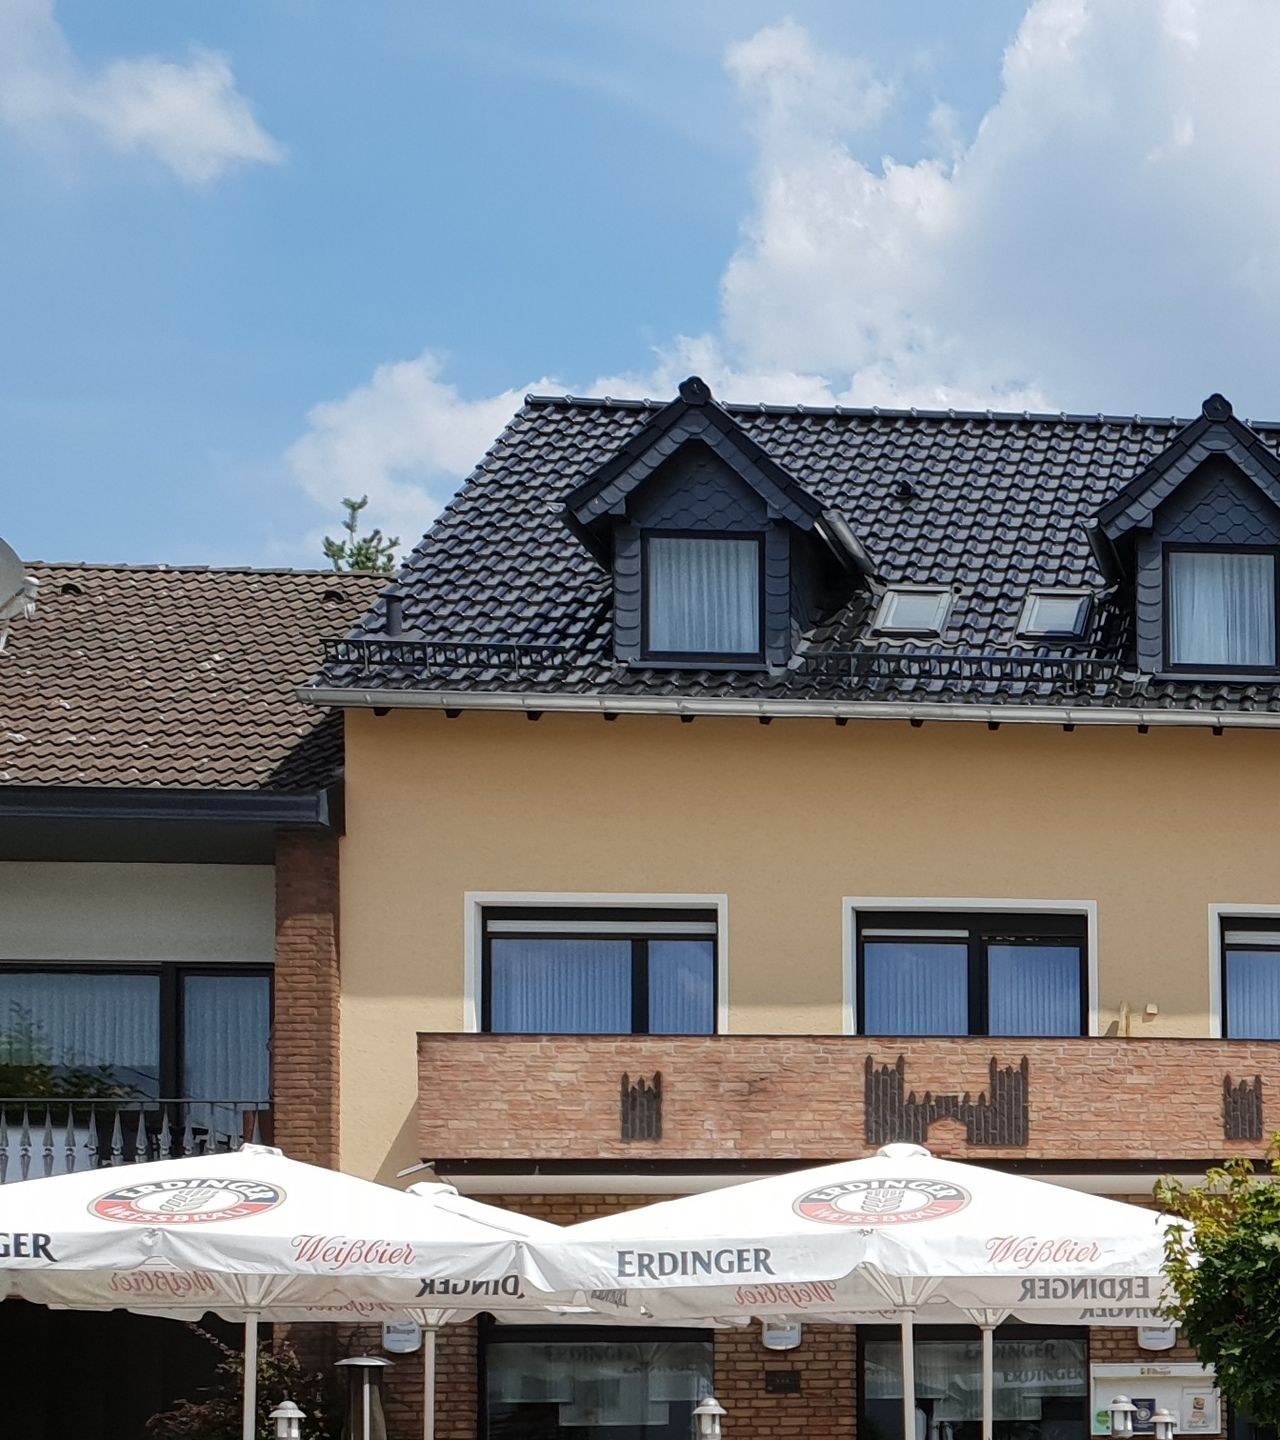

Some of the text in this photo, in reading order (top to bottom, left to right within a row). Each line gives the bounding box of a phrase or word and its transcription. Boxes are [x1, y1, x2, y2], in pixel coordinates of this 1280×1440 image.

[120, 1179, 275, 1200] ERDINGER
[808, 1180, 960, 1200] ERDINGER
[290, 1234, 416, 1270] Weißbier
[617, 1247, 776, 1280] ERDINGER
[985, 1235, 1102, 1270] Weißbier
